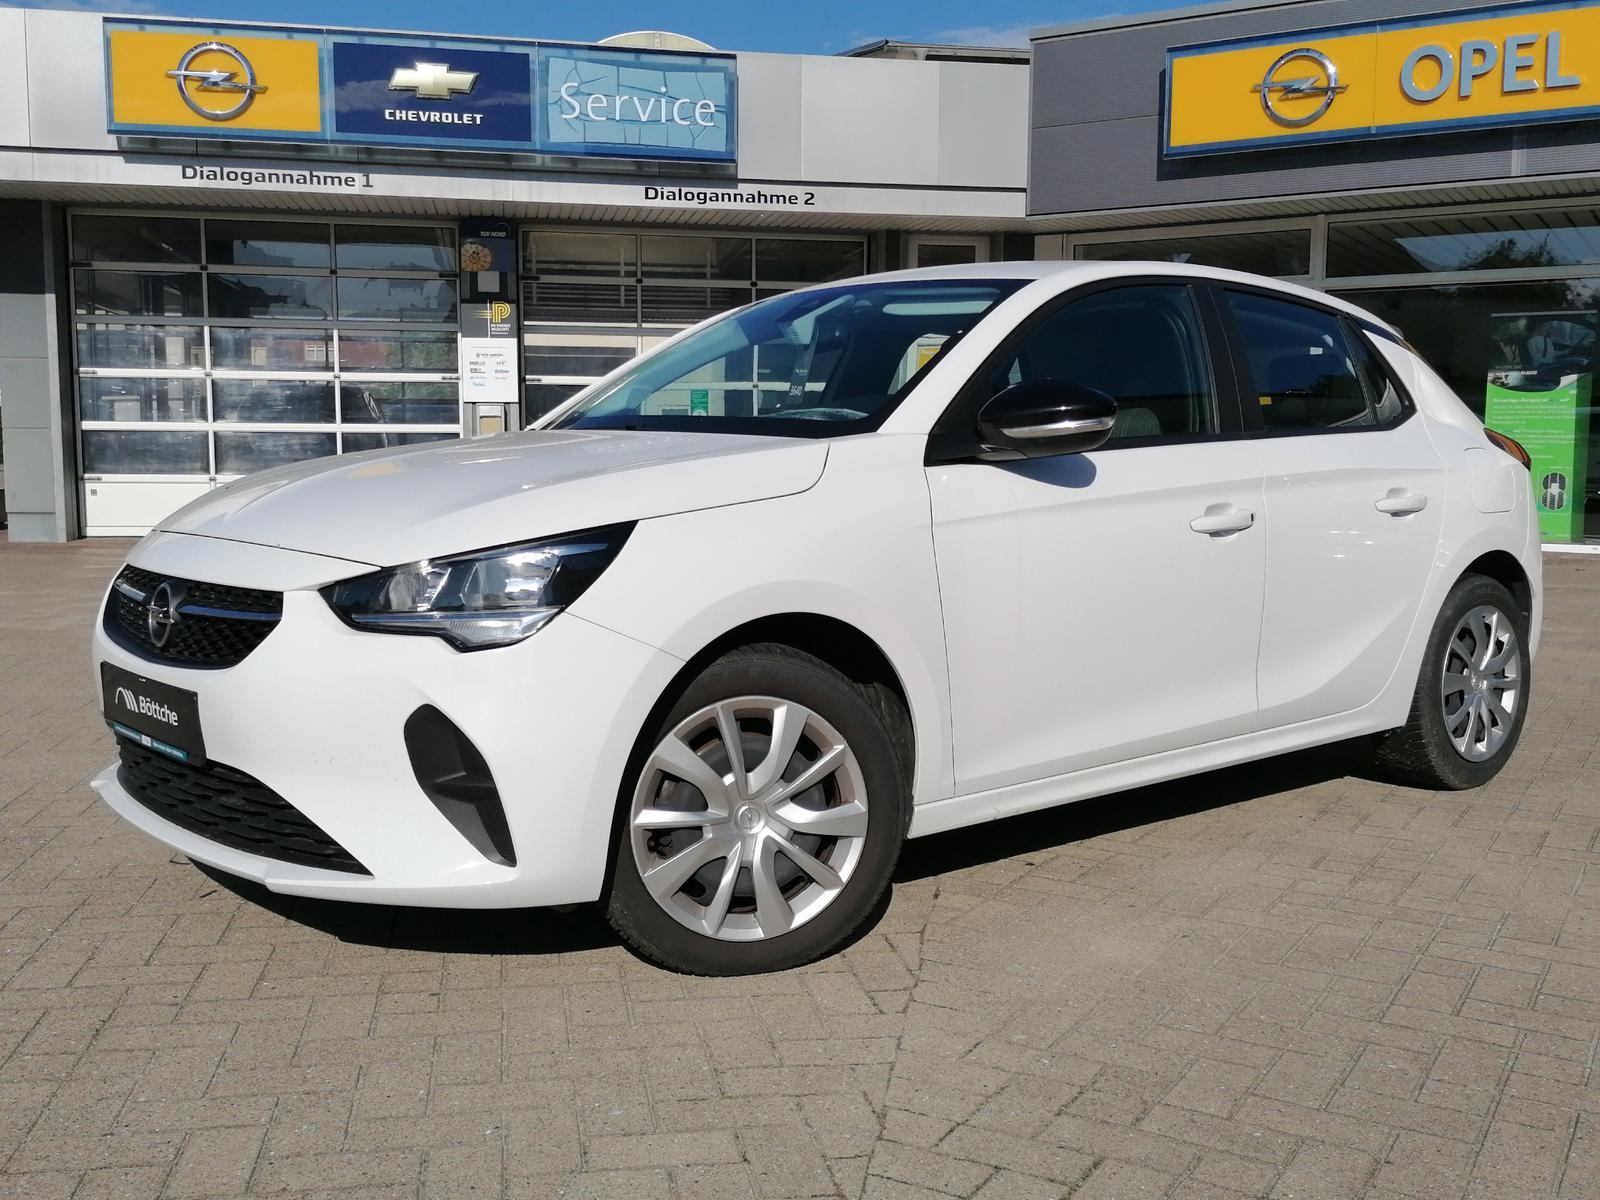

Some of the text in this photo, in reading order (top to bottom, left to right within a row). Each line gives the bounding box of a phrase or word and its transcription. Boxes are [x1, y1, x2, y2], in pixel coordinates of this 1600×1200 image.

[1399, 31, 1582, 102] OPEL
[384, 108, 484, 125] CHEVROLET
[560, 81, 716, 127] Service
[181, 165, 374, 188] Dialogannahme 1
[644, 186, 816, 206] Dialogannahme 2
[139, 695, 179, 726] Böttche
